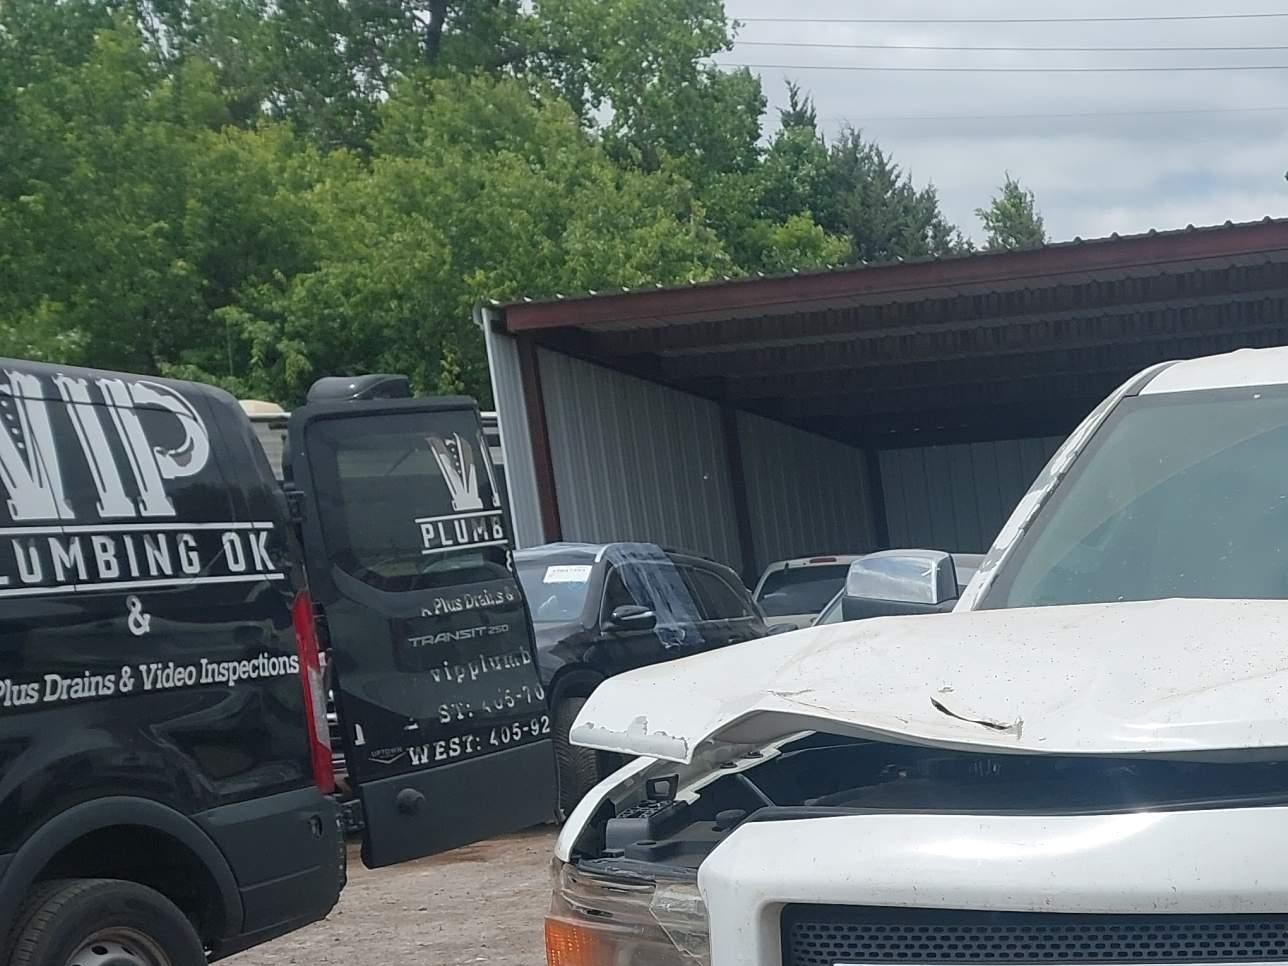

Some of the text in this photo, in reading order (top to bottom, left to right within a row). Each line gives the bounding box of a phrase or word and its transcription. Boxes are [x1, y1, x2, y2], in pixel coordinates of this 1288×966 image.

[0, 367, 210, 521] VIP
[221, 530, 276, 573] OK
[126, 595, 151, 636] &
[433, 596, 463, 616] Plus
[408, 624, 509, 647] TRANSIT 250
[43, 670, 115, 702] Drains
[119, 665, 135, 692] &
[139, 661, 196, 690] Video
[200, 652, 300, 687] Inspections
[406, 715, 551, 765] WEST: 405-92
